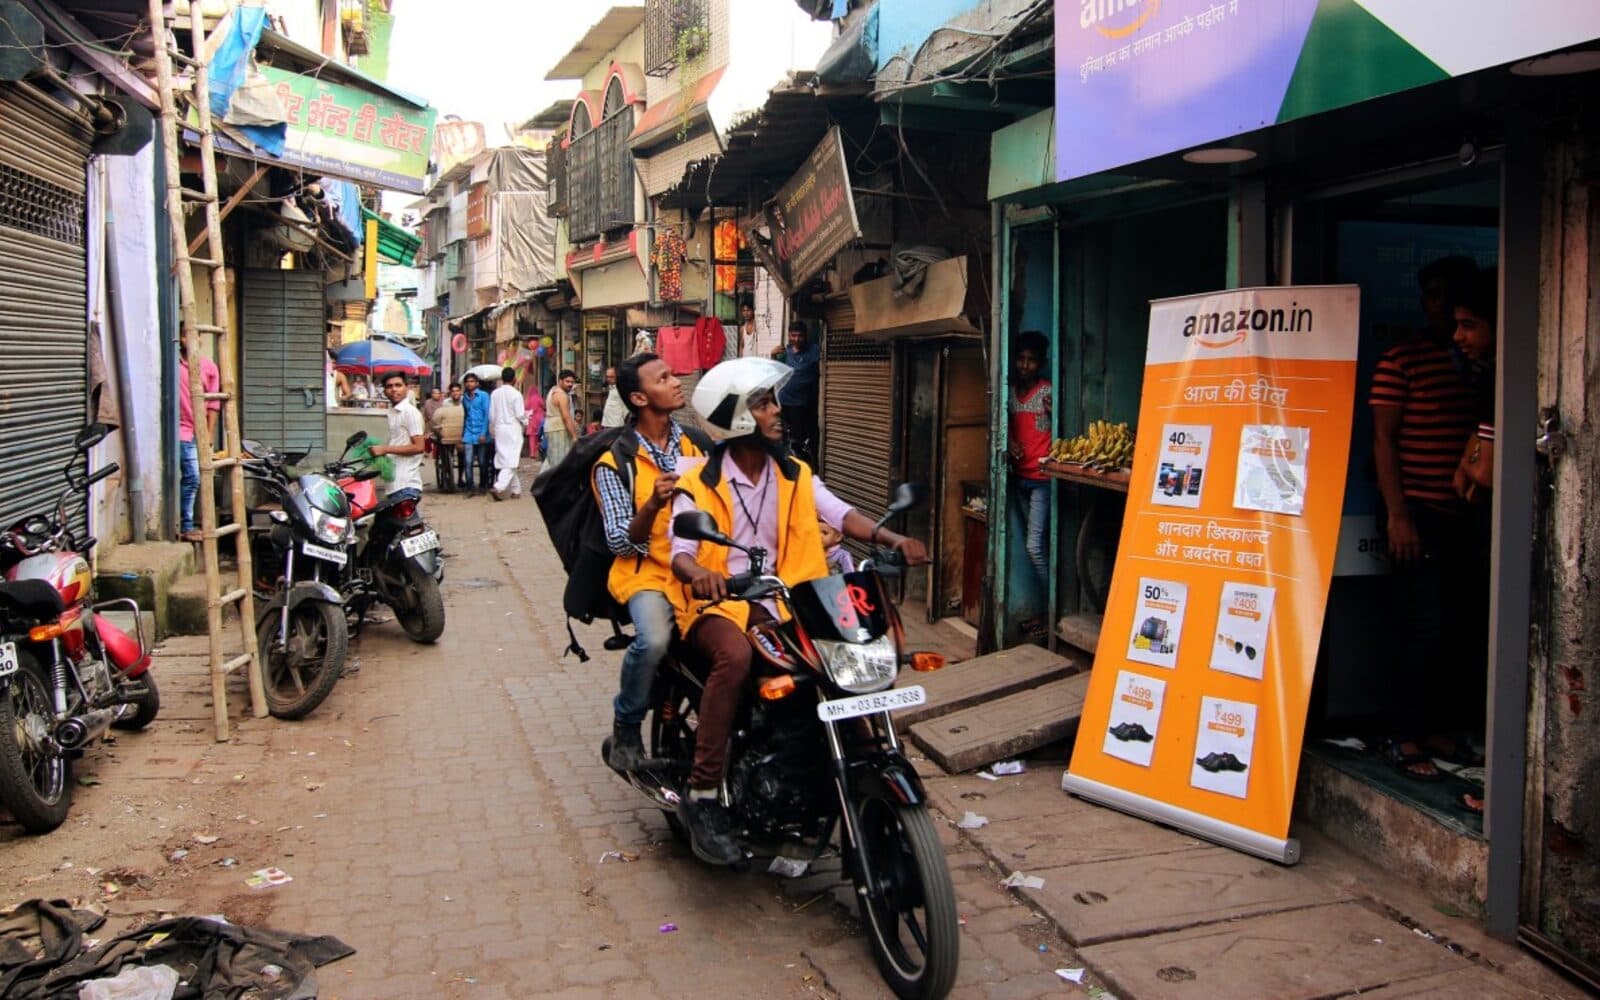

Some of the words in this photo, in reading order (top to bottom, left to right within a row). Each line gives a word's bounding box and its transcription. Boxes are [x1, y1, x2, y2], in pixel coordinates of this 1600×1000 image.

[1133, 32, 1161, 56] सामान
[1164, 15, 1194, 43] आपके
[1183, 302, 1312, 338] amazon.in
[1184, 385, 1218, 402] आज
[1224, 379, 1246, 402] की
[1248, 378, 1288, 406] डील
[1157, 521, 1202, 538] शानदार
[1155, 539, 1179, 558] और
[1236, 551, 1265, 567] बचत
